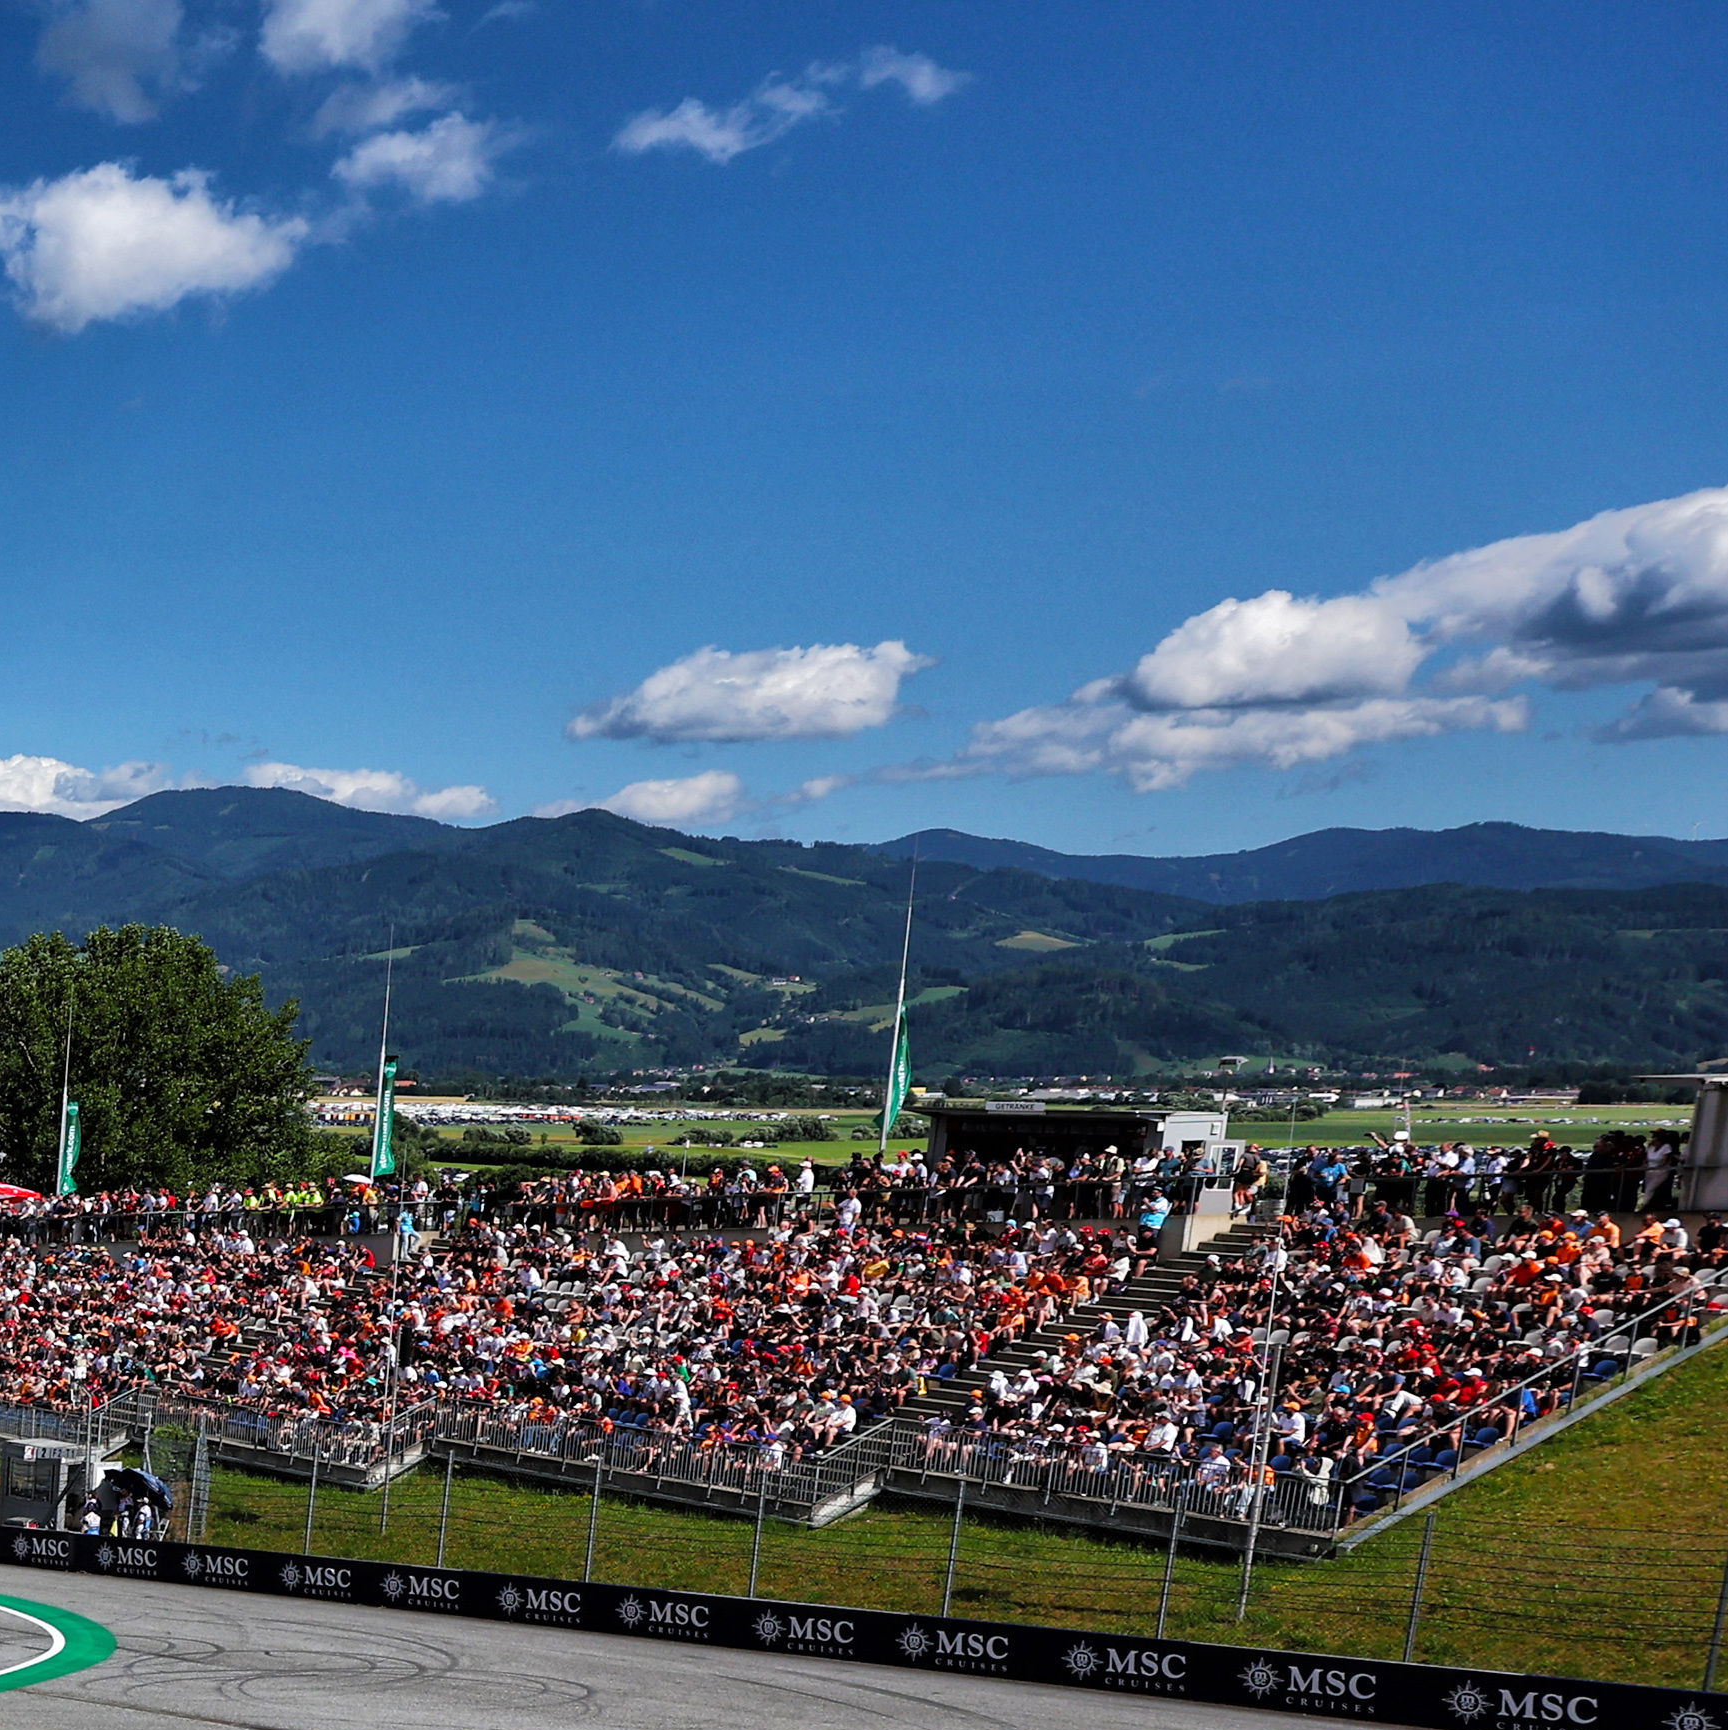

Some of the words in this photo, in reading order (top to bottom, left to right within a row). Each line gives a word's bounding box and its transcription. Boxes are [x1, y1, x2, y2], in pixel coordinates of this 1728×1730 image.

[32, 1539, 70, 1559] MSC
[116, 1546, 157, 1567] MSC
[31, 1557, 70, 1567] CRUISES
[116, 1566, 157, 1576] CRUISES
[205, 1555, 249, 1577] MSC
[205, 1575, 249, 1586] CRUISES
[304, 1566, 351, 1588] MSC
[304, 1587, 351, 1598] CRUISES
[408, 1575, 460, 1600] MSC
[408, 1599, 460, 1611] CRUISES
[525, 1589, 581, 1613] MSC
[525, 1613, 581, 1624] CRUISES
[649, 1600, 710, 1628] MSC
[648, 1625, 709, 1638] CRUISES
[788, 1616, 855, 1644] MSC
[787, 1642, 854, 1656] CRUISES
[936, 1631, 1009, 1660] MSC
[935, 1657, 1008, 1673] CRUISES
[1106, 1648, 1187, 1680] MSC
[1105, 1677, 1186, 1692] CRUISES
[1287, 1665, 1377, 1700] MSC
[1286, 1697, 1375, 1714] CRUISES
[1498, 1689, 1598, 1725] MSC
